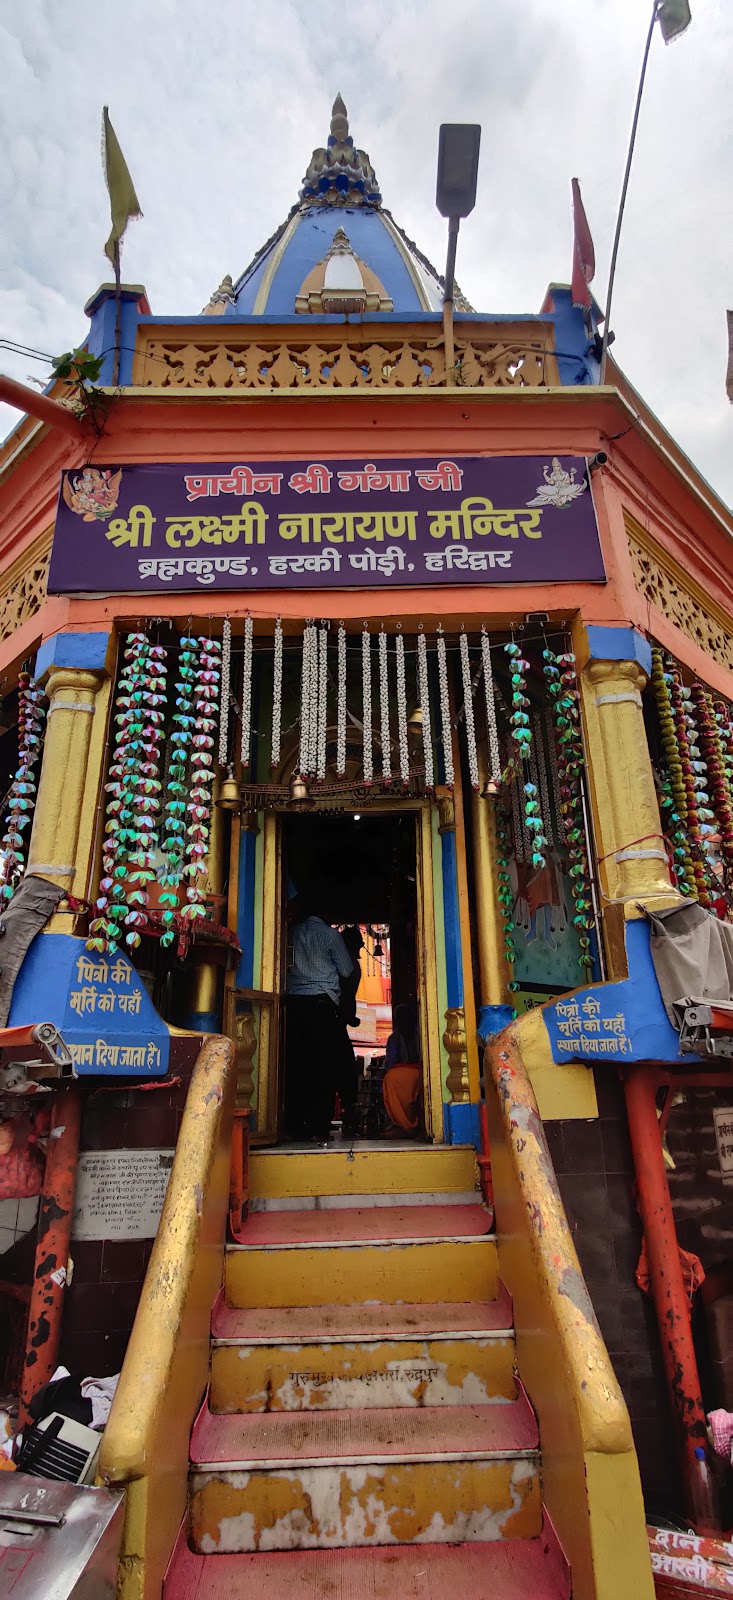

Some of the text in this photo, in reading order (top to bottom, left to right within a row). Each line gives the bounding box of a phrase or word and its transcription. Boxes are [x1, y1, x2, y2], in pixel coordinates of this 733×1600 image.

[184, 461, 463, 501] प्राचीन श्री गंगा जी
[105, 497, 543, 548] श्री लक्ष्मी नारायण मन्दिर
[138, 545, 513, 584] ब्रह्मकुण्ड, हरकी पोड़ी, हरिद्वार
[76, 956, 132, 985] पित्रो की
[70, 985, 142, 1017] मूर्ति को यहाँ
[555, 998, 579, 1018] पित्रो
[581, 996, 600, 1014] की
[556, 1012, 625, 1037] मूर्ति को यहाँ
[96, 1039, 120, 1067] दिया
[120, 1046, 147, 1067] जाता
[557, 1040, 580, 1053] स्थान
[580, 1034, 599, 1056] दिया
[599, 1038, 618, 1053] जाता
